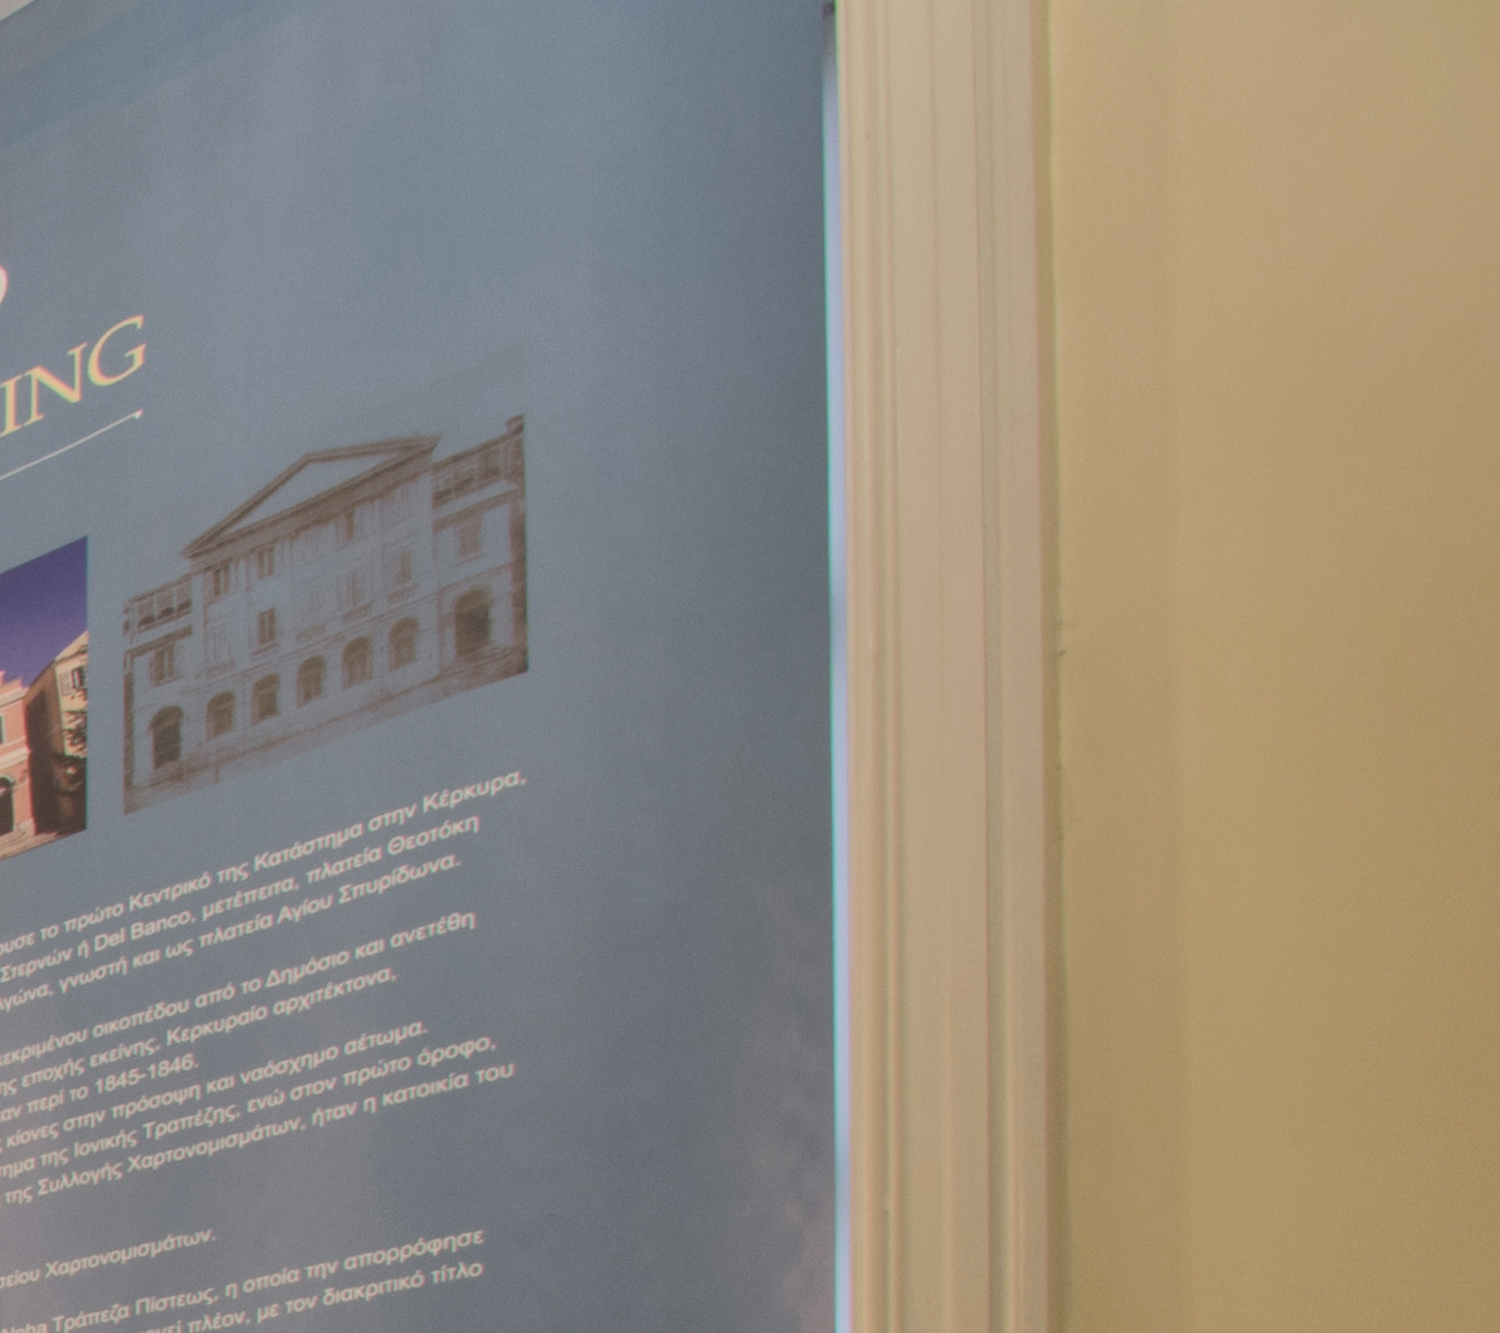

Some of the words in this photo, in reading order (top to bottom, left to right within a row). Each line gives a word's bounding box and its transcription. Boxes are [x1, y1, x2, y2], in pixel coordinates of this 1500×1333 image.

[38, 923, 59, 941] το
[63, 902, 124, 933] πρώτο
[128, 869, 211, 913] Κεντρικό
[215, 861, 249, 884] της
[253, 822, 363, 872] Κατάστημα
[367, 803, 416, 831] στην
[77, 938, 89, 958] ή
[93, 926, 125, 952] Del
[129, 909, 196, 941] Banco,
[305, 846, 382, 884] πλατεία
[385, 814, 478, 855] Θεοτόκη
[91, 997, 190, 1038] οικοπέδου
[194, 980, 236, 1008] από
[239, 977, 262, 994] το
[264, 949, 350, 988] Δημόσιο
[354, 937, 385, 960] και
[388, 911, 475, 949] ανετέθη
